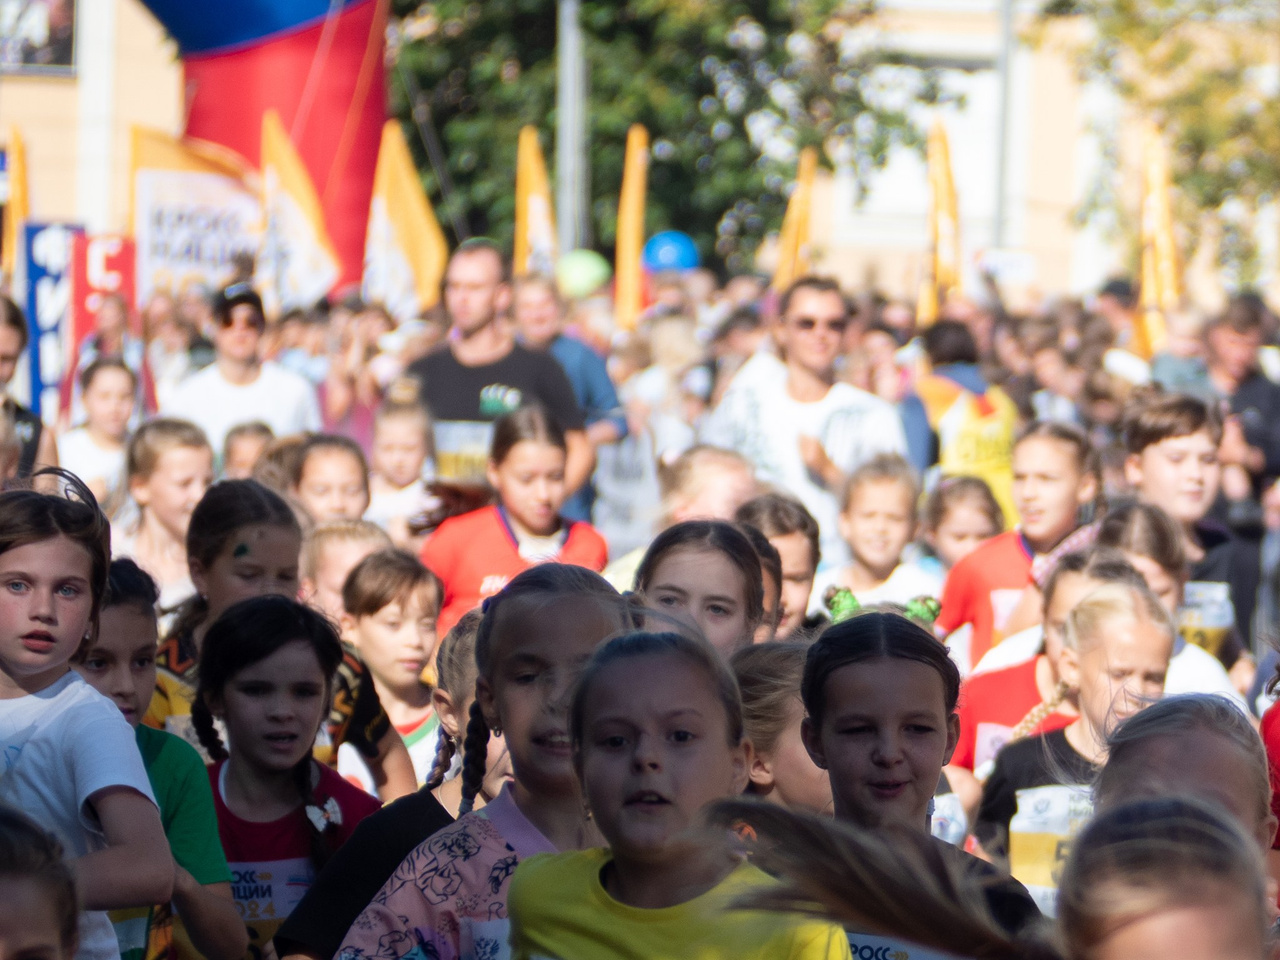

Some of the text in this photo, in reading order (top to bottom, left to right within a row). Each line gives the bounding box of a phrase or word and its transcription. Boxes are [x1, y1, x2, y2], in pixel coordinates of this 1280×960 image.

[231, 870, 256, 885] ОСС
[232, 885, 272, 900] ЦИИ
[234, 901, 276, 919] 024
